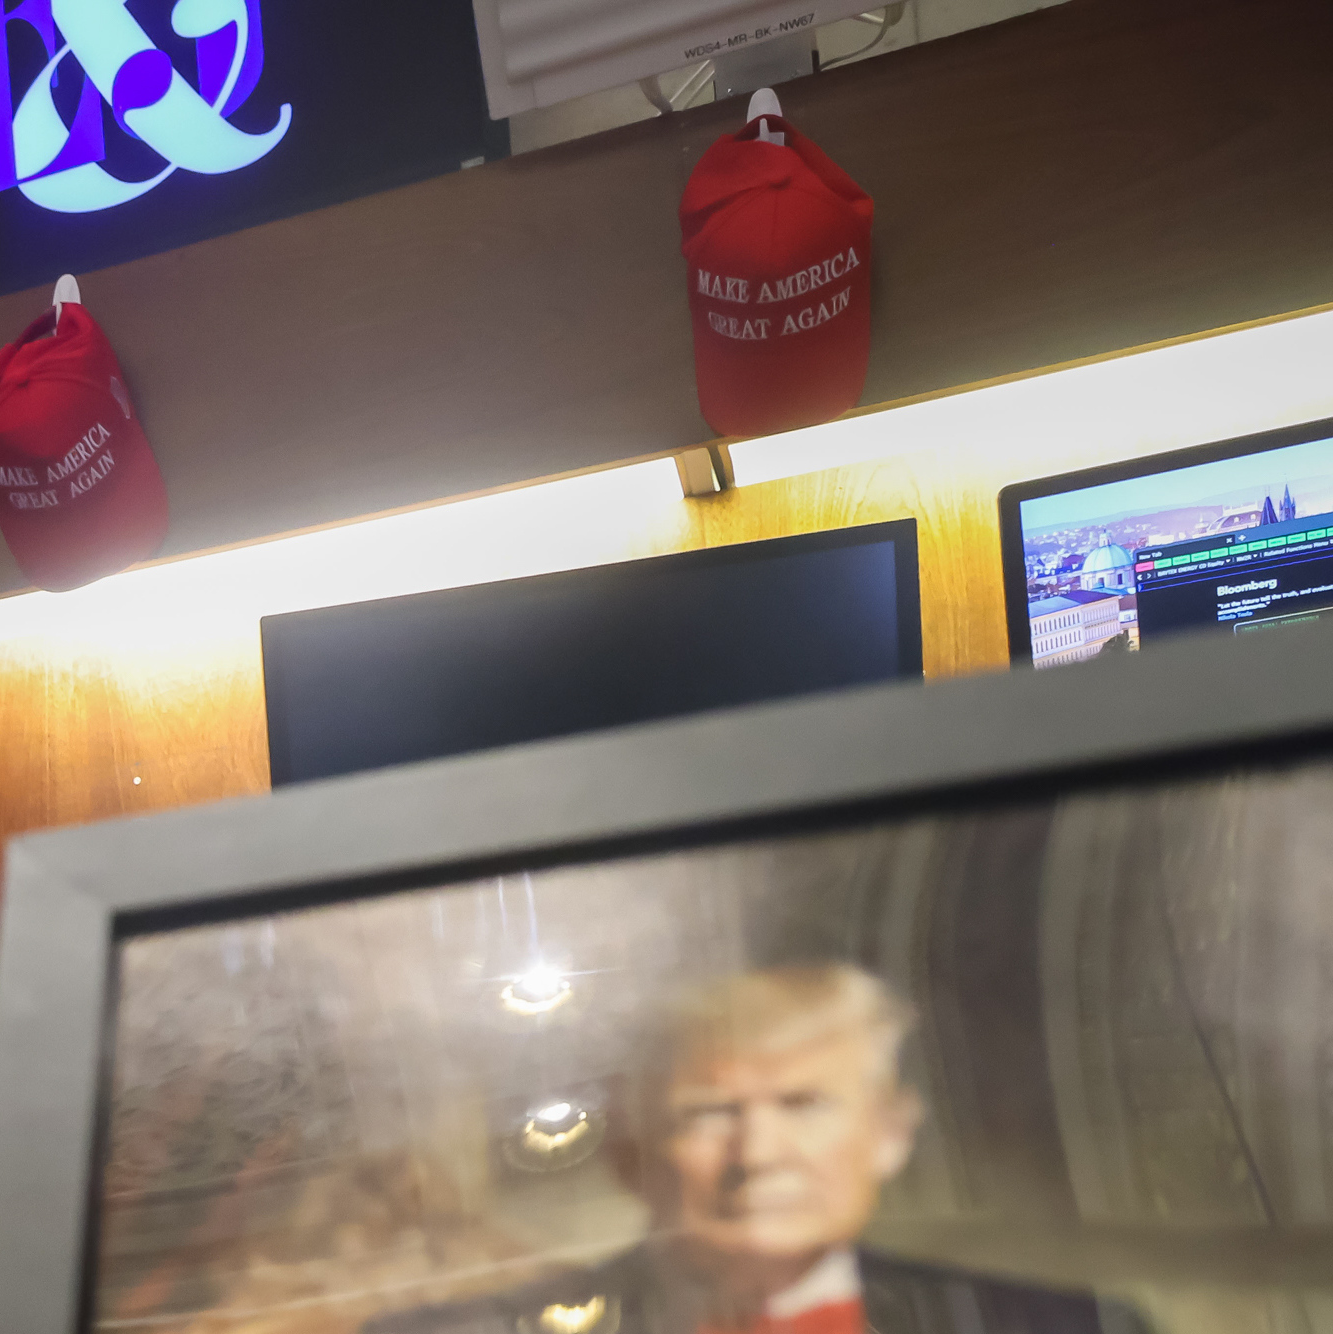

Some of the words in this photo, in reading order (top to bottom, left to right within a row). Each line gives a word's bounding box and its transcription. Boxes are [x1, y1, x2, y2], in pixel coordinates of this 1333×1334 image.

[698, 269, 749, 303] MAKE
[756, 247, 859, 303] AMERICA
[709, 312, 771, 339] GREAT
[781, 286, 851, 336] AGAIN
[10, 490, 60, 509] GREAT
[70, 450, 115, 498] AGAIN
[47, 423, 111, 483] AMERICA
[1217, 579, 1278, 596] Bloomberg
